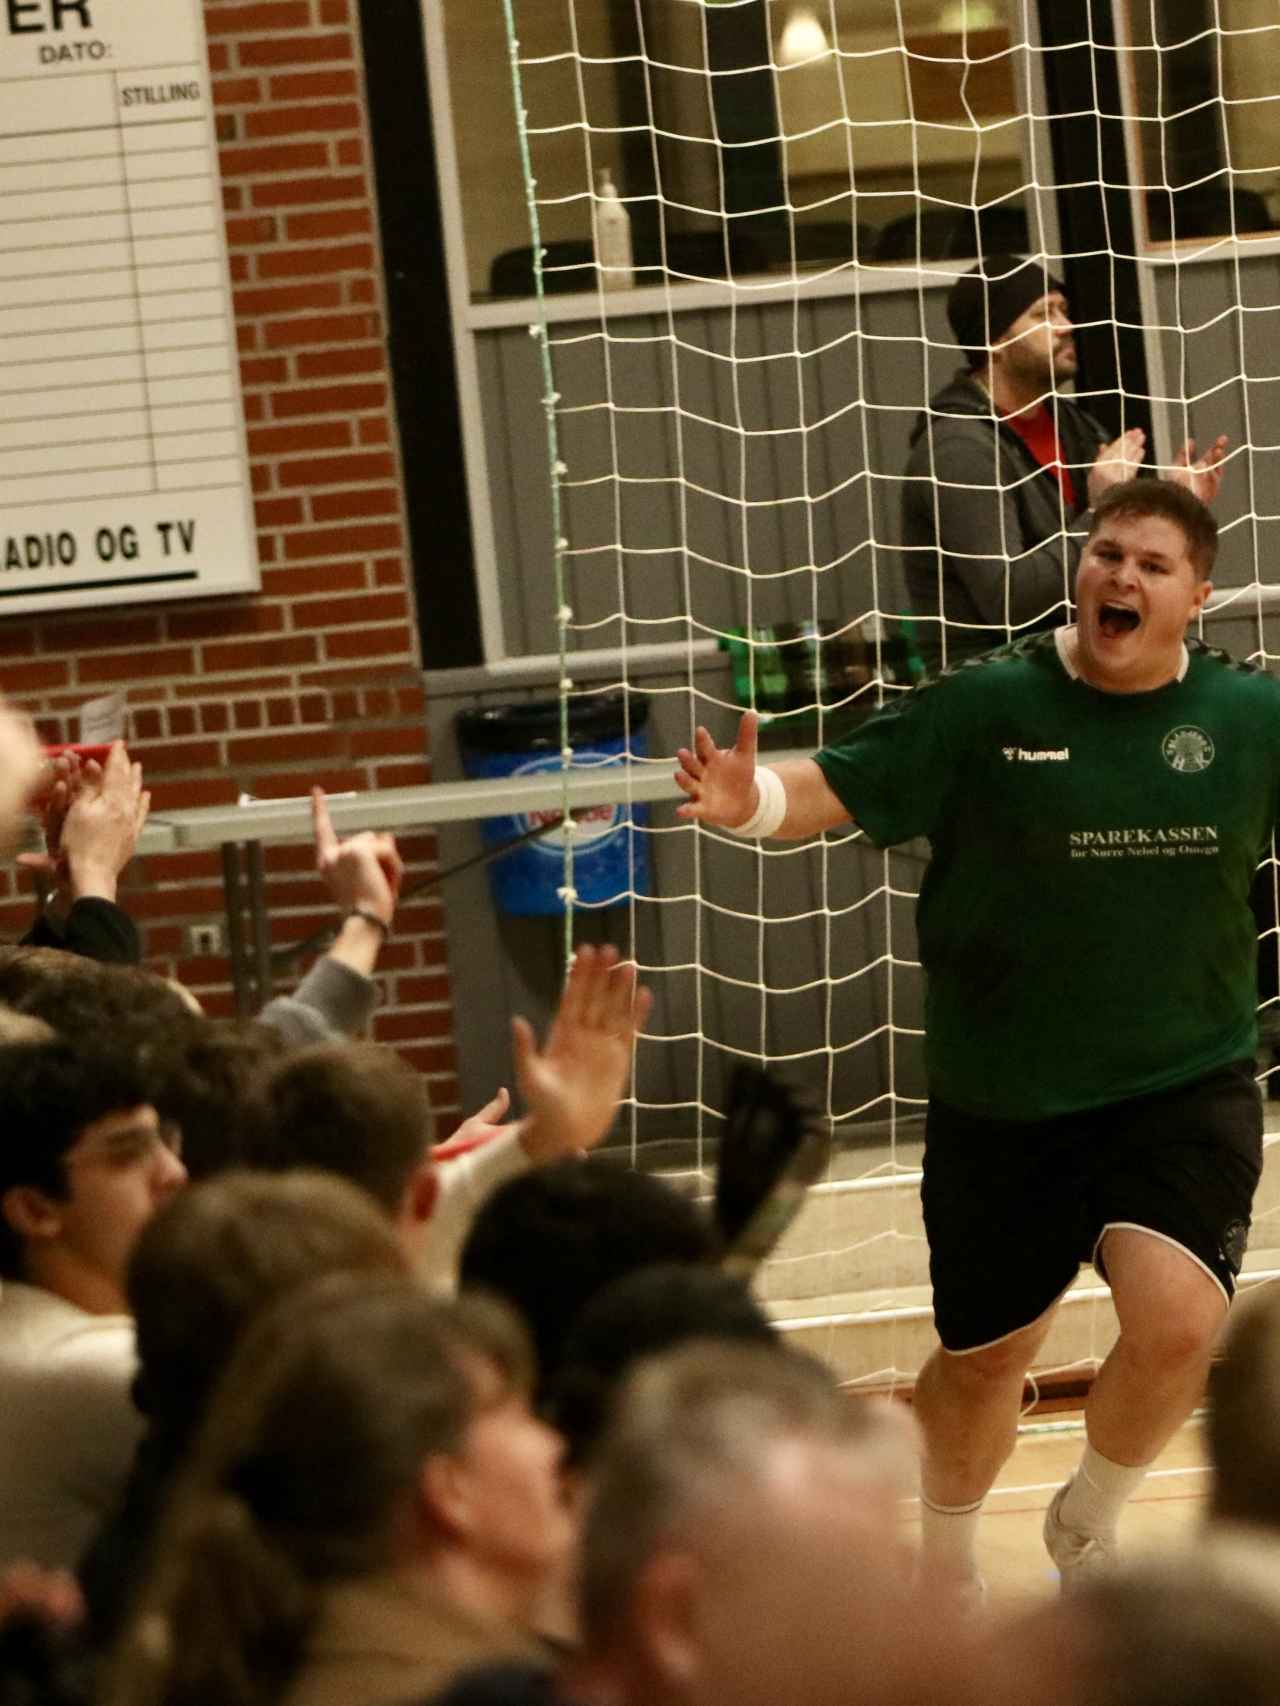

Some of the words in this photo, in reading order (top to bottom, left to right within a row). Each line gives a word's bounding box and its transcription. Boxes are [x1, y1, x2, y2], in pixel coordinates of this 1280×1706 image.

[121, 81, 200, 106] STILLING
[0, 531, 77, 572] ADIO
[96, 524, 140, 563] OG
[156, 518, 196, 556] TV
[1018, 747, 1069, 761] hummel
[1070, 826, 1218, 845] SPAREKASSEN
